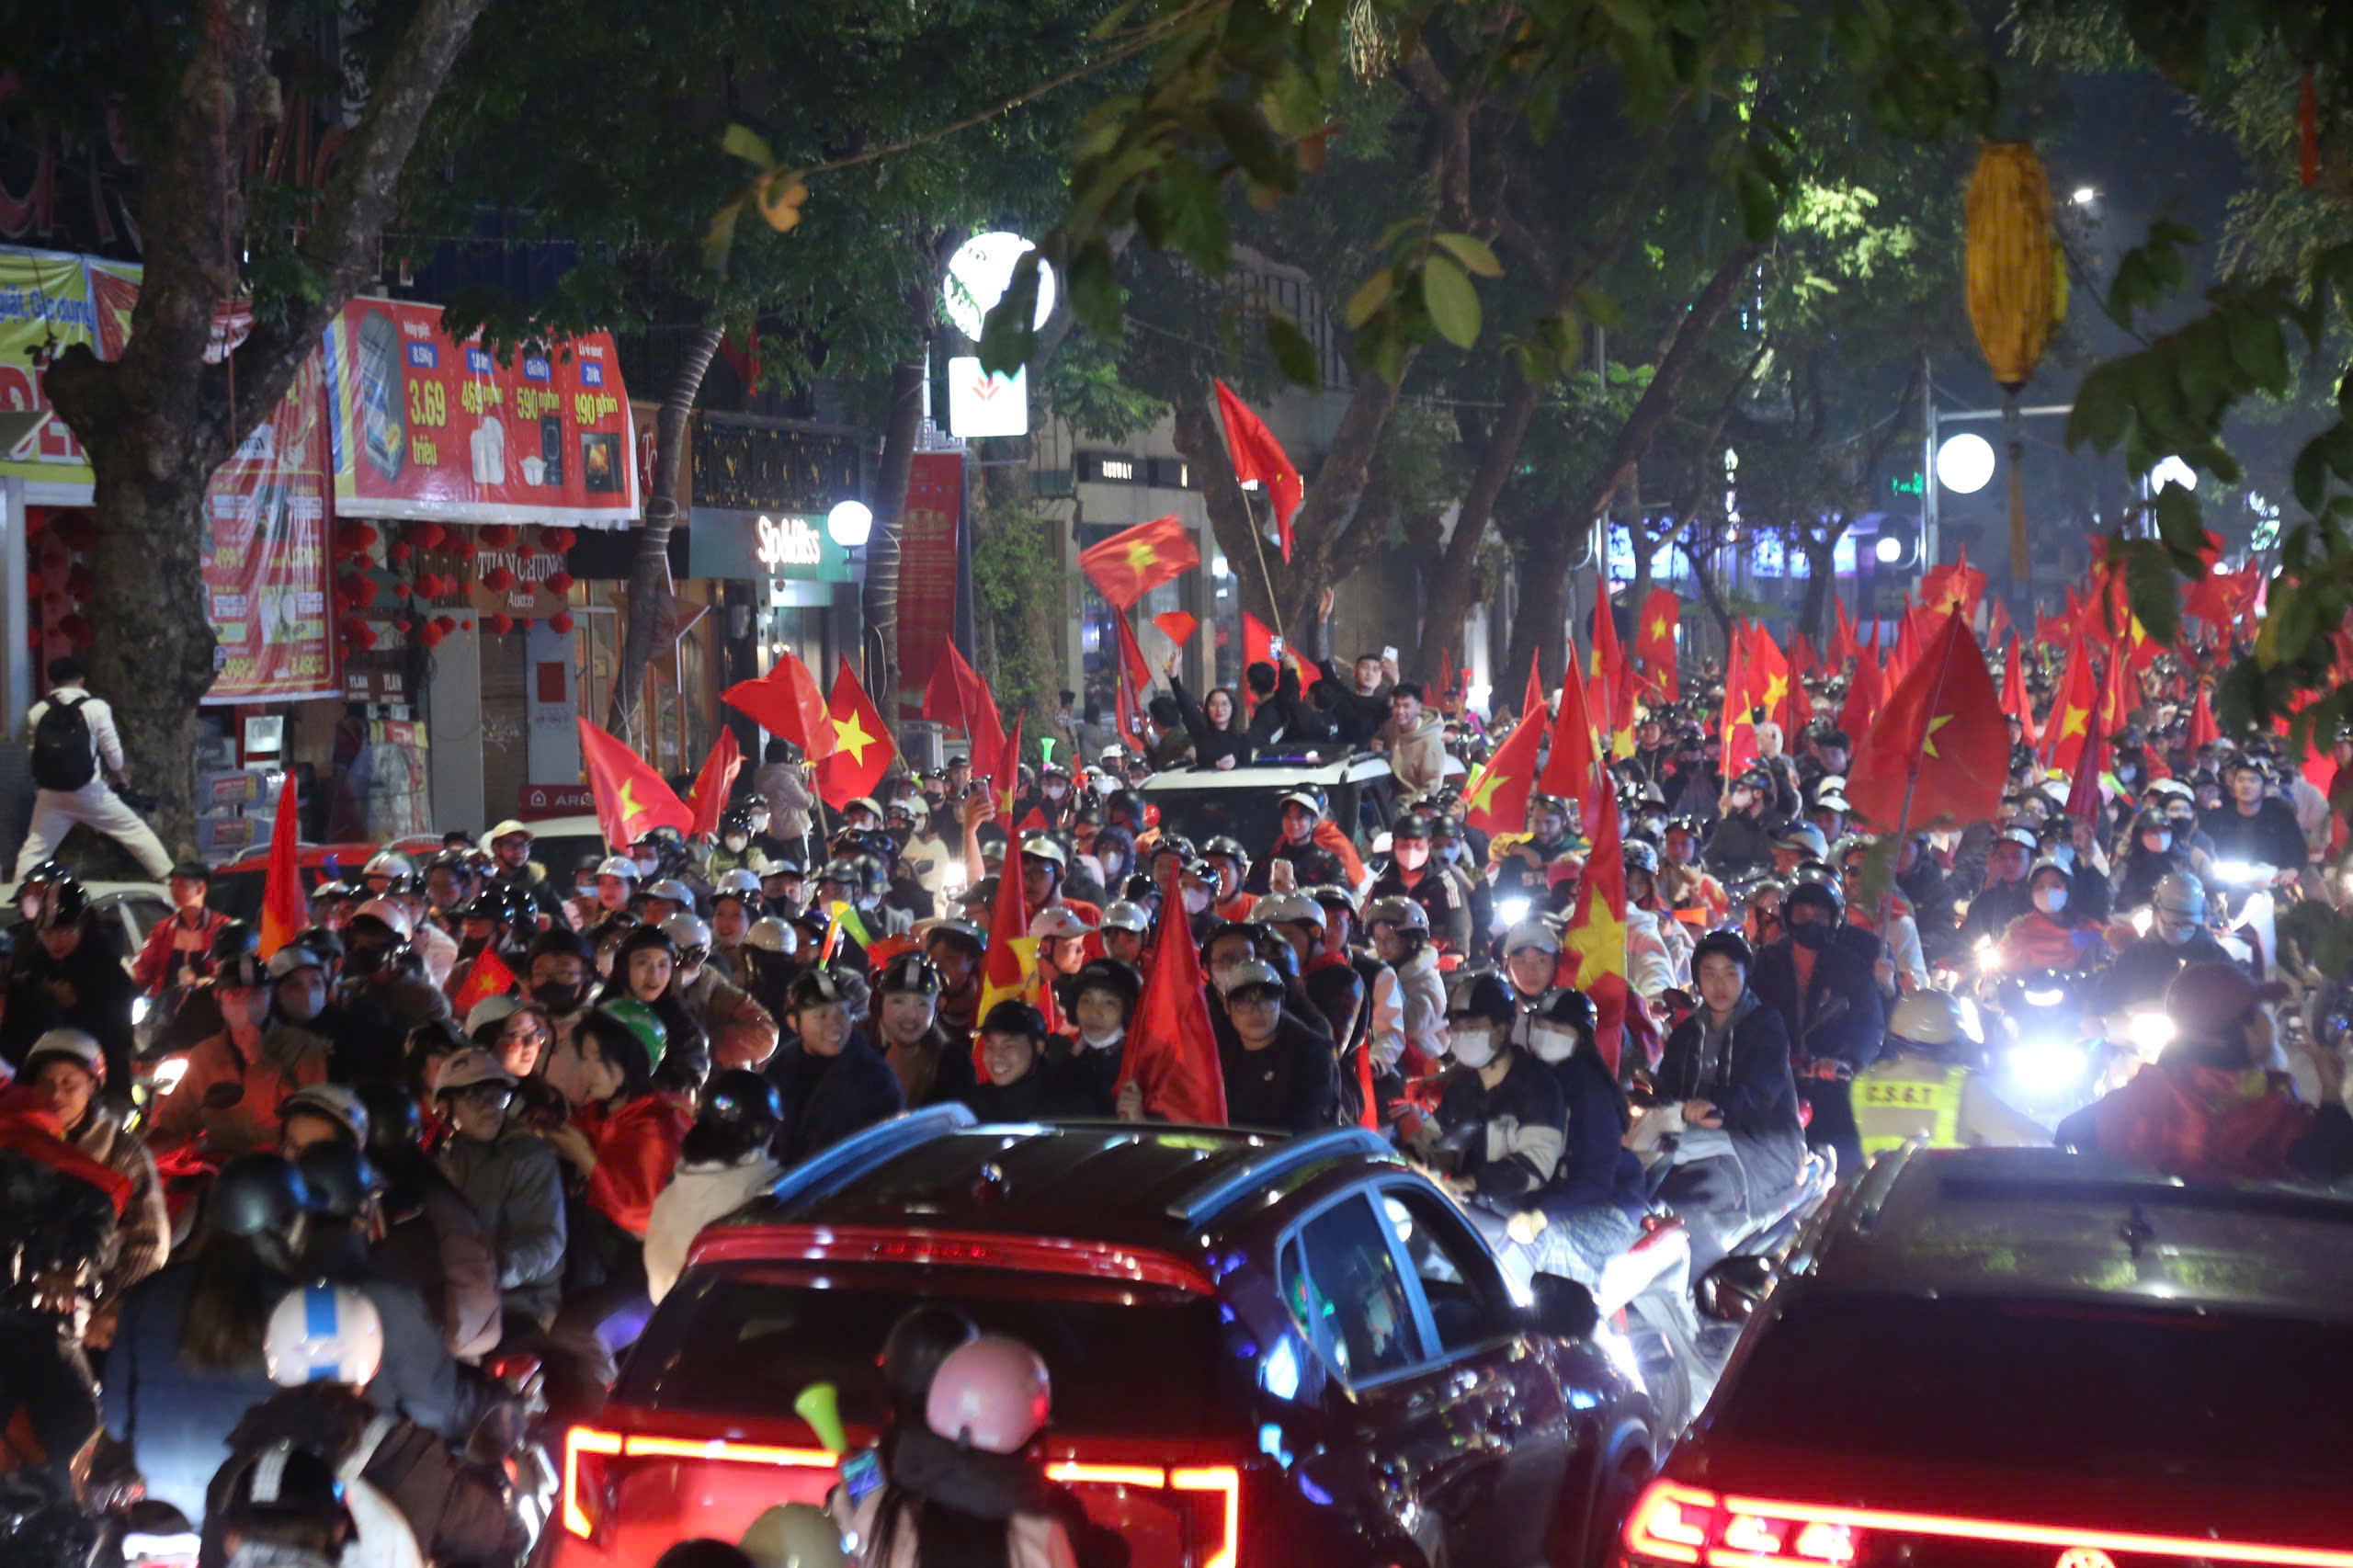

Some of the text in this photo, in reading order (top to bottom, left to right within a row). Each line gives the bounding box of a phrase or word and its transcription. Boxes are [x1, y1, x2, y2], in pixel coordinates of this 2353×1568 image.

[410, 378, 446, 427] 3.69
[461, 381, 483, 415] 469
[517, 387, 538, 419] 590
[574, 392, 596, 425] 990
[412, 433, 438, 472] triệu
[507, 591, 535, 608] Audio
